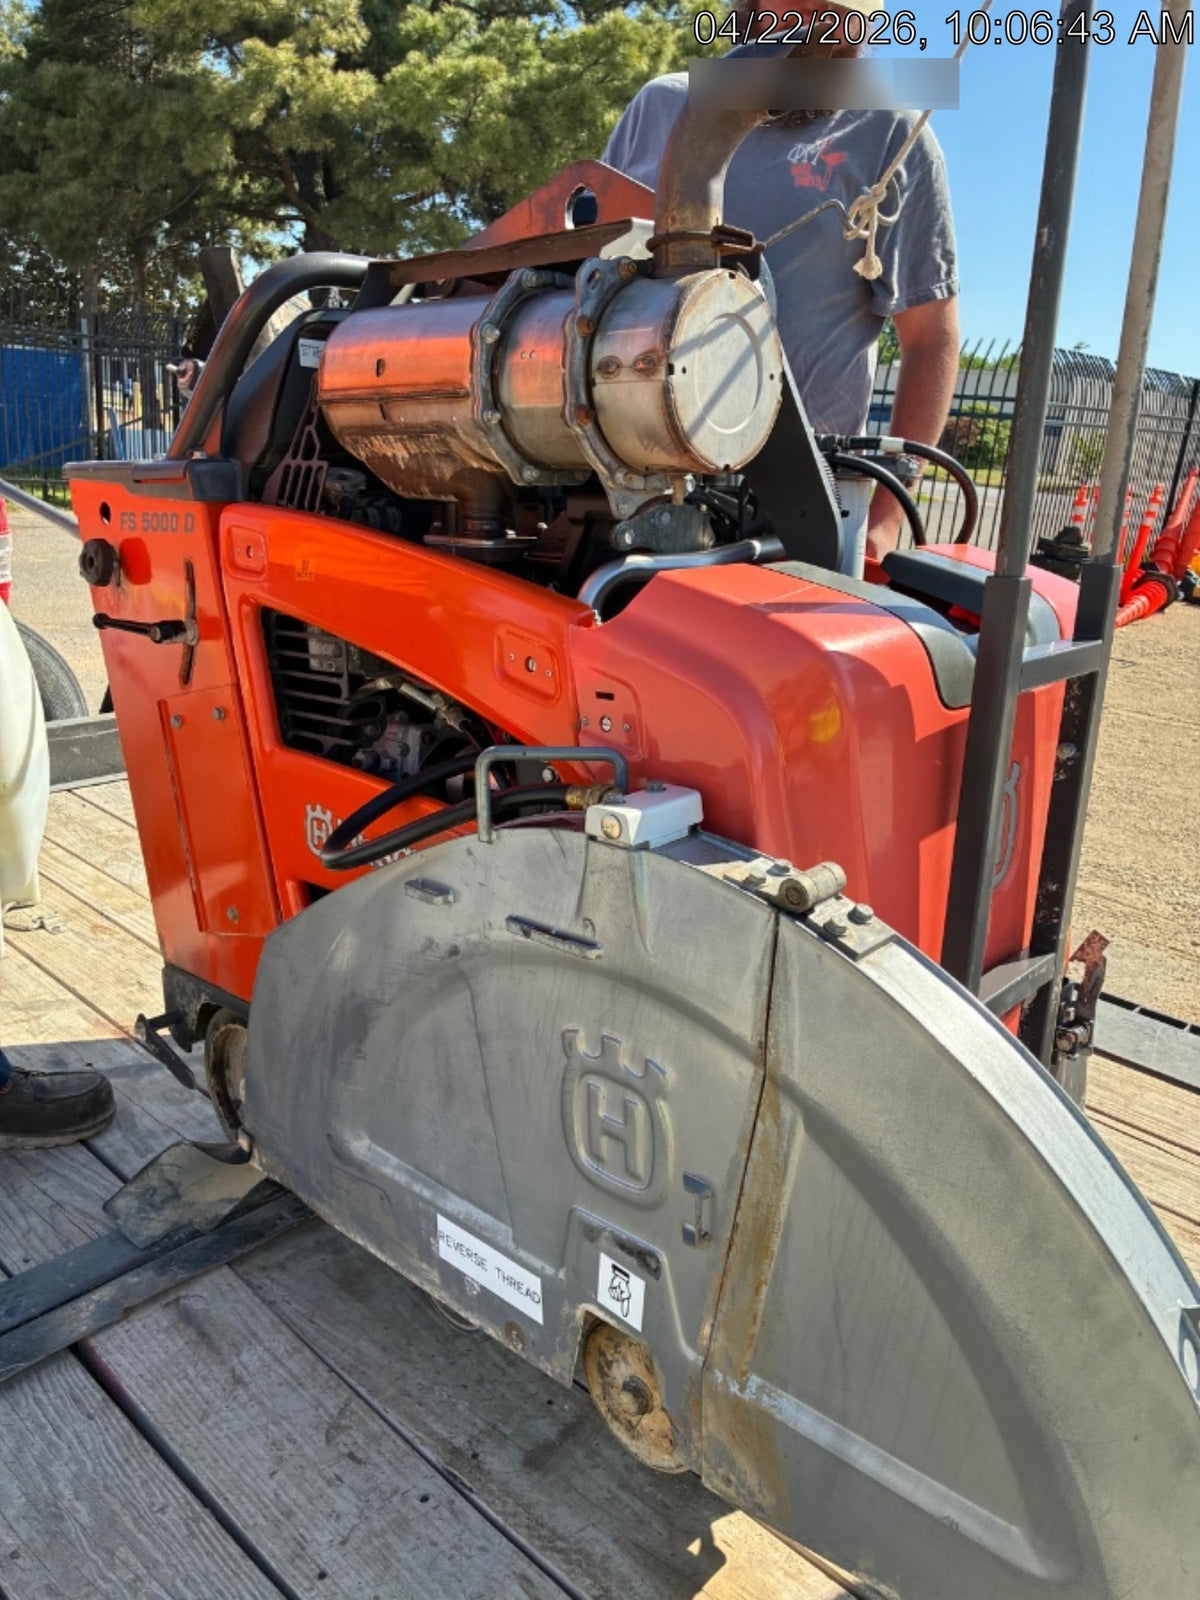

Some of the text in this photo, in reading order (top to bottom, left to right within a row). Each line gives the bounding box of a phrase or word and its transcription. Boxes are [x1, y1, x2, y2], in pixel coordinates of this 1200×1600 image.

[120, 511, 196, 535] FS 5000 D
[438, 1229, 541, 1305] REVERSE THREAD
